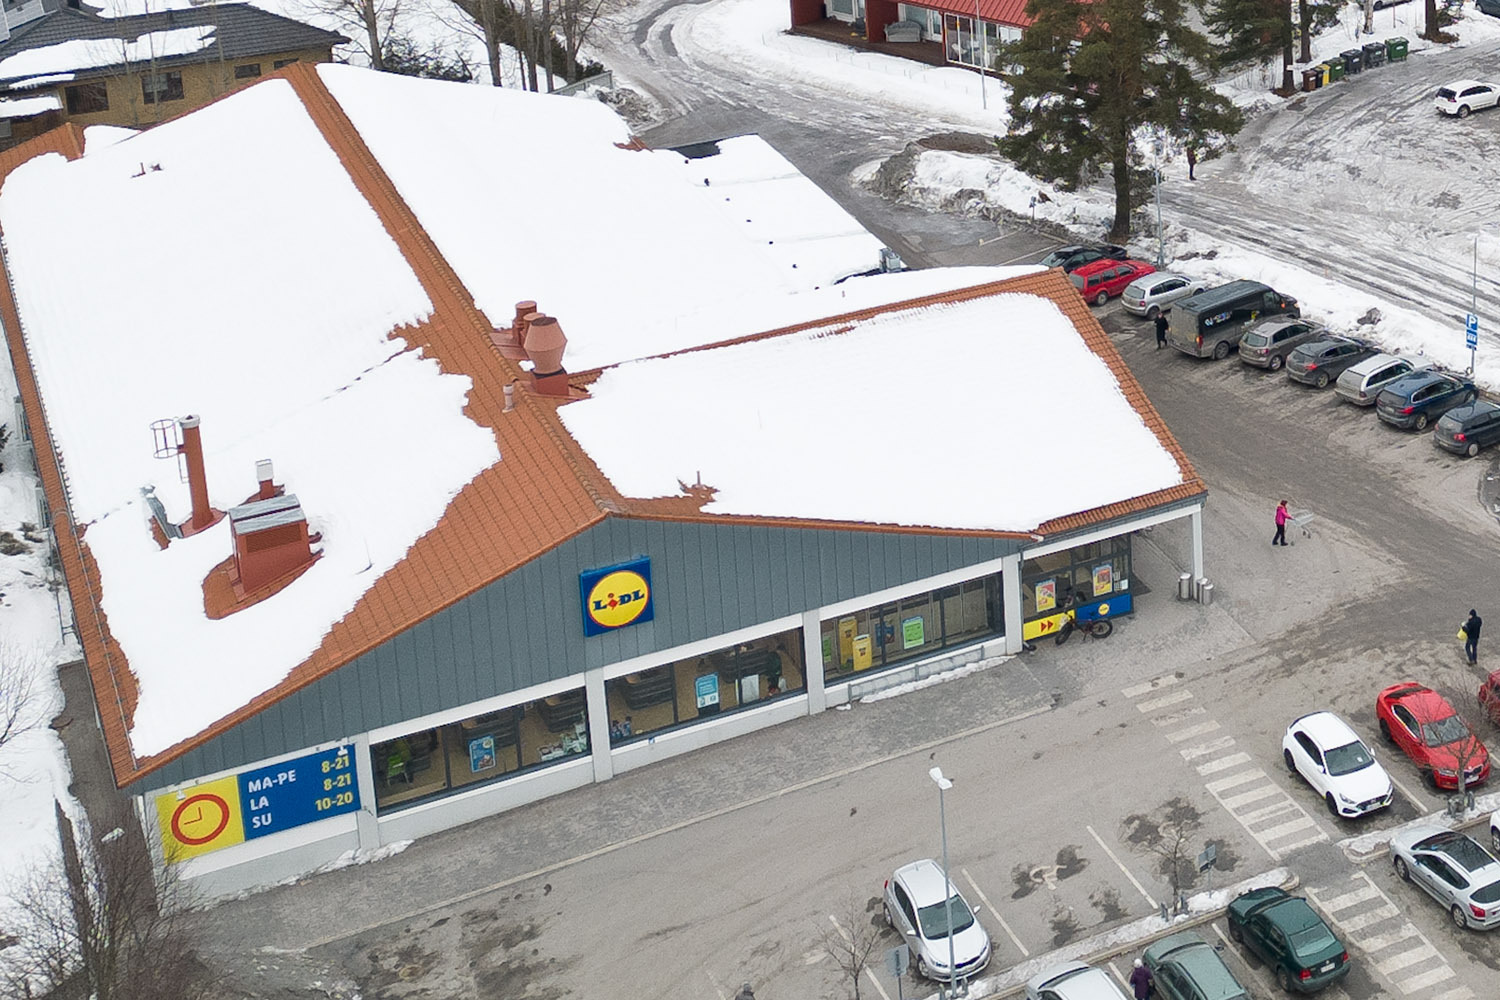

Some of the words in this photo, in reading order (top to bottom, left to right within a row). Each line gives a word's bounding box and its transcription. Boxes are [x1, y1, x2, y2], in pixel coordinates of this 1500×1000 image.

[248, 770, 296, 793] MA-PE
[321, 757, 350, 773] 8-21
[250, 796, 269, 811] LA
[323, 773, 352, 791] 8-21
[252, 813, 272, 829] SU
[315, 792, 354, 811] 10-20
